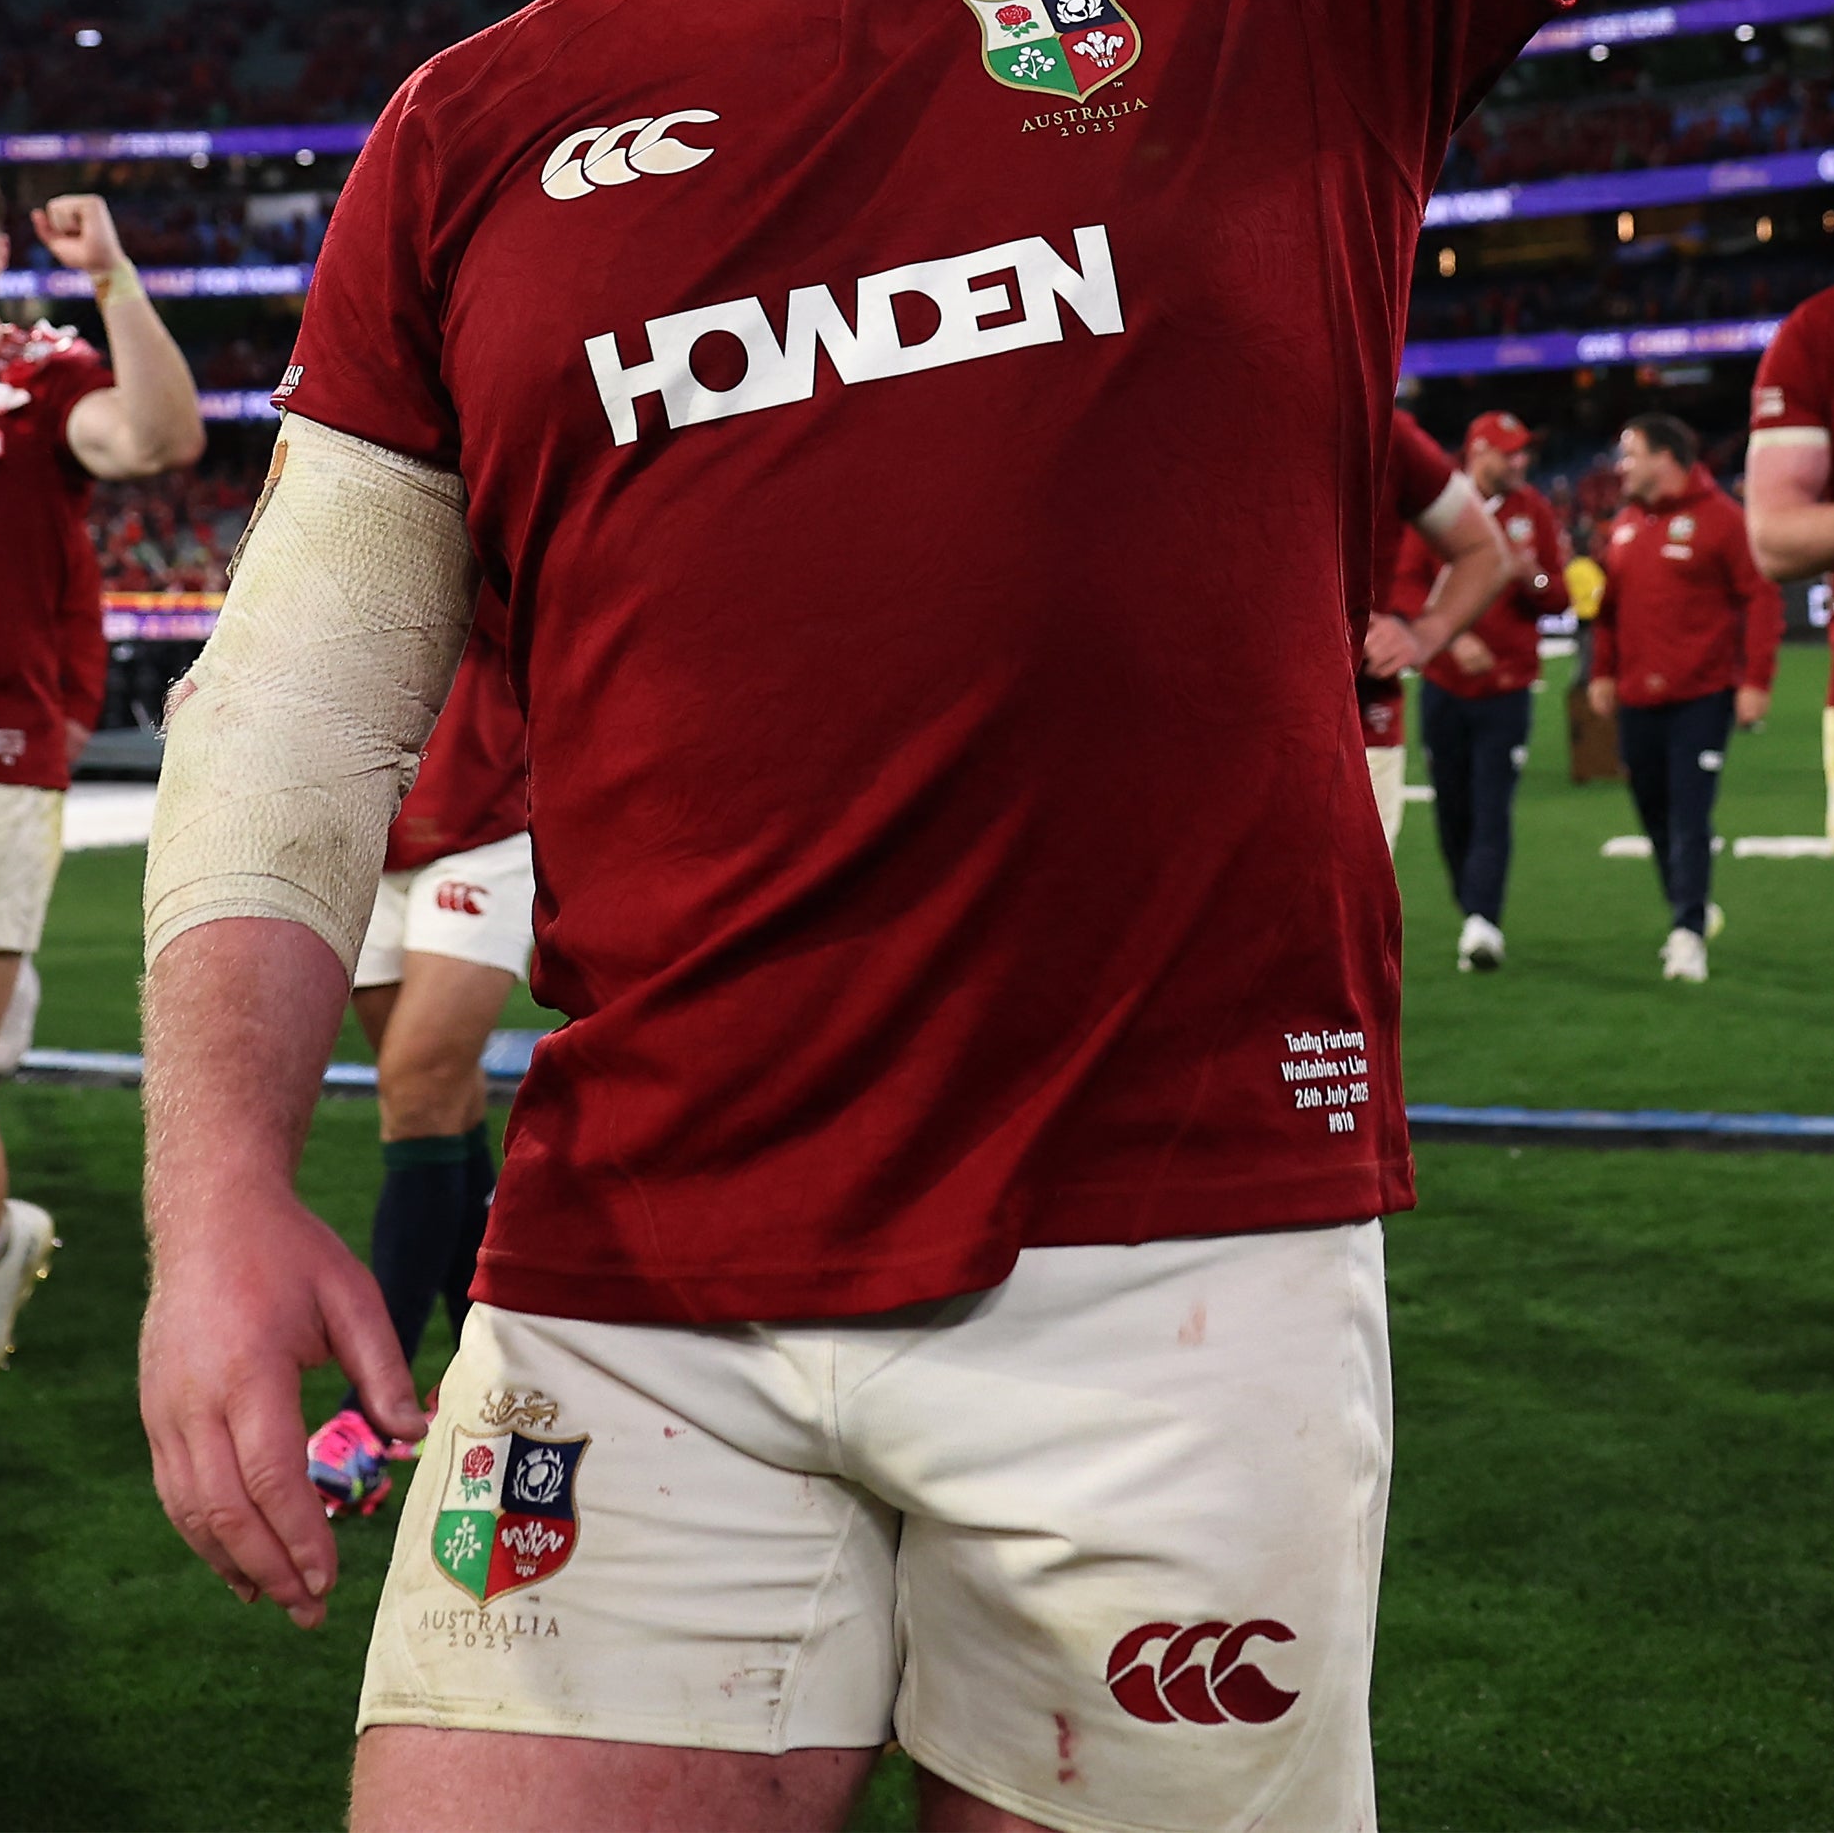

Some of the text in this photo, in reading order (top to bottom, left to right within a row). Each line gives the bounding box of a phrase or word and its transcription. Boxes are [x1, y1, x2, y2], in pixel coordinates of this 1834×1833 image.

[1021, 97, 1149, 133] AUSTRALIA
[1060, 120, 1116, 138] 2025
[584, 223, 1126, 447] HOWDEN
[1284, 1029, 1365, 1055] Tadhg Furlong
[1281, 1058, 1340, 1082] Wallabies
[1339, 1061, 1348, 1076] v
[1295, 1087, 1323, 1109] 26th
[1324, 1084, 1348, 1109] July
[418, 1609, 560, 1638] AUSTRALIA
[448, 1633, 513, 1653] 2025
